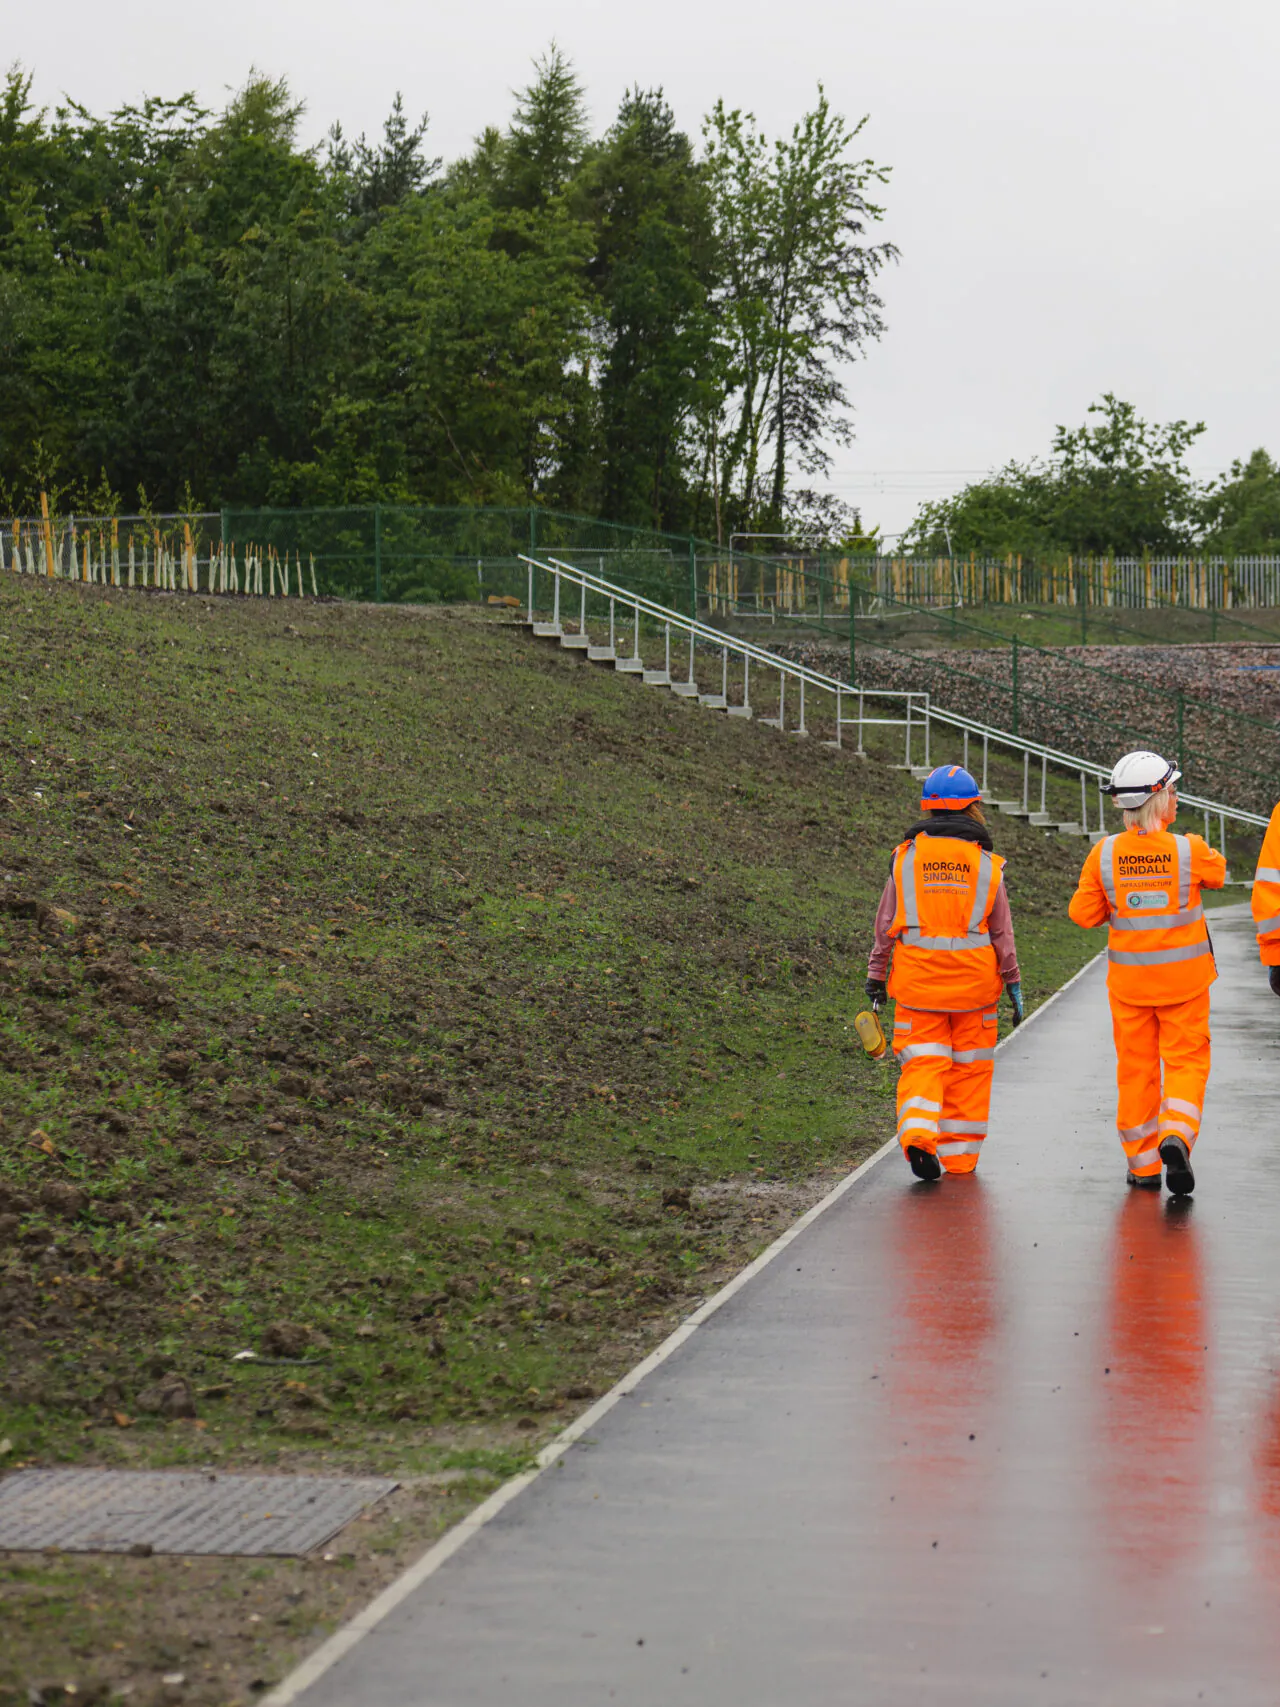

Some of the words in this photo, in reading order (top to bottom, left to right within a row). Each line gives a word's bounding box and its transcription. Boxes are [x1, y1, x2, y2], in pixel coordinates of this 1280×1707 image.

[1118, 853, 1171, 865] MORGAN
[923, 861, 970, 873] MORGAN
[1119, 864, 1170, 875] SINDALL
[923, 872, 967, 883] SINDALL
